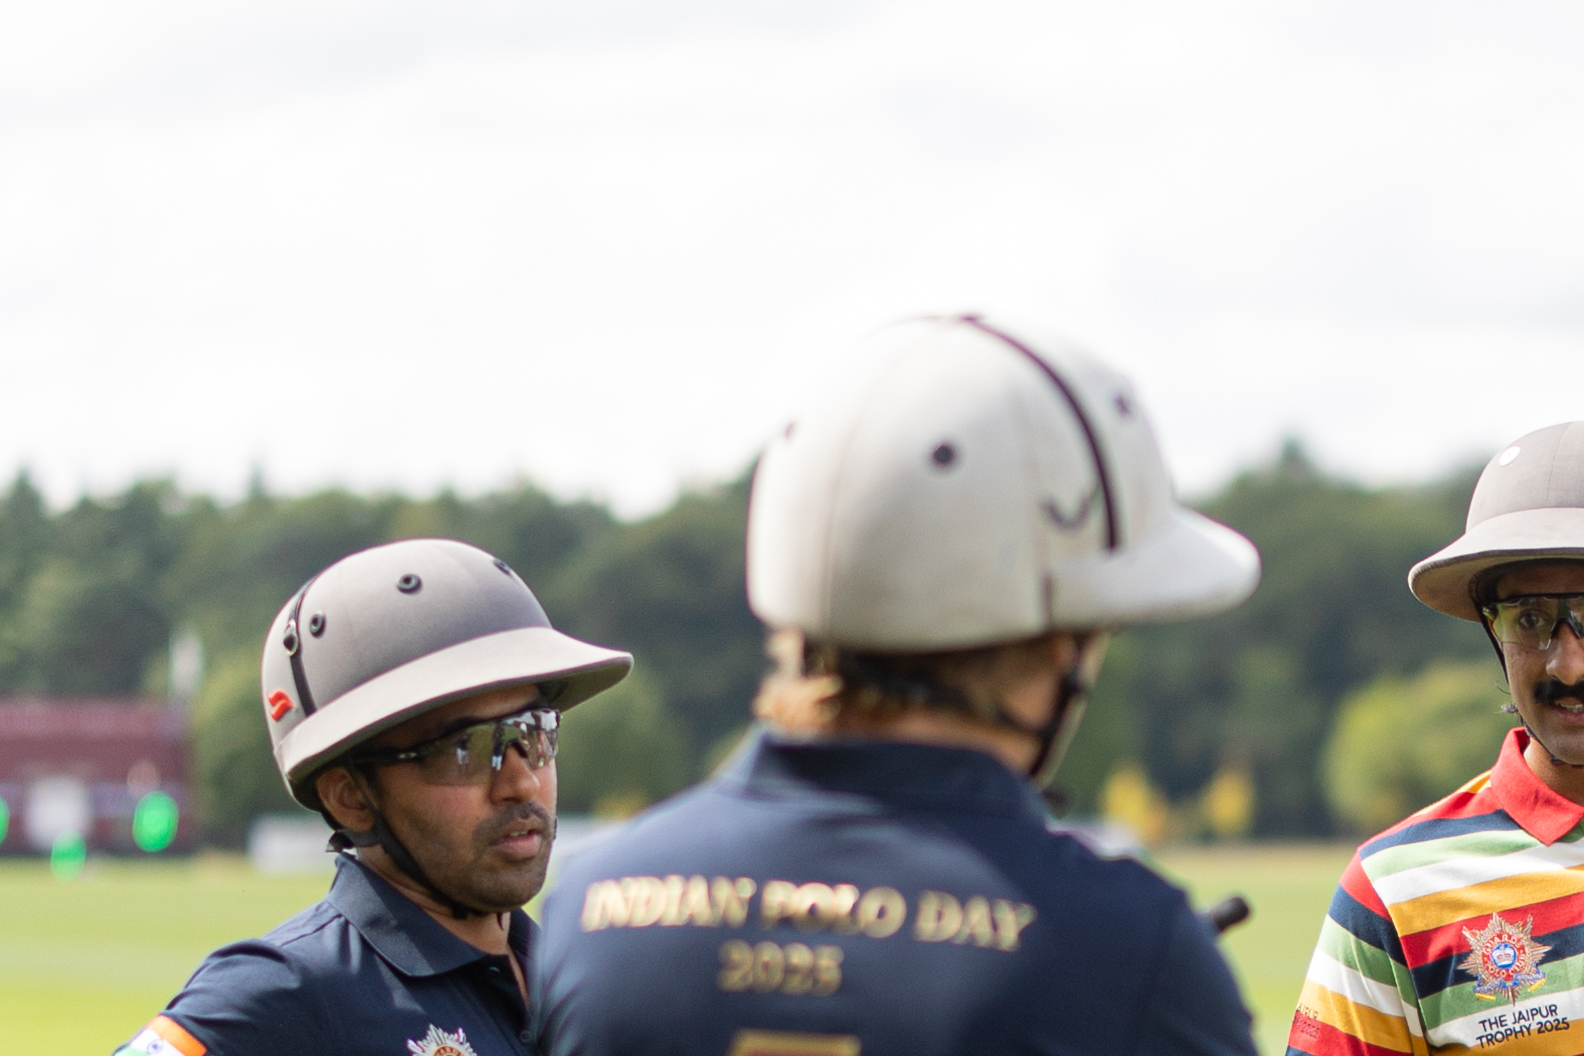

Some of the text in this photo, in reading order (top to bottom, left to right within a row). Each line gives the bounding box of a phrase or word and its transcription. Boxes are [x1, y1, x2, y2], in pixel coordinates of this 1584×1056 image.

[581, 874, 1037, 952] INDIAN POLO DAY
[1475, 1017, 1570, 1049] TROPHY 2025
[1479, 1004, 1559, 1033] THE JAIPUR
